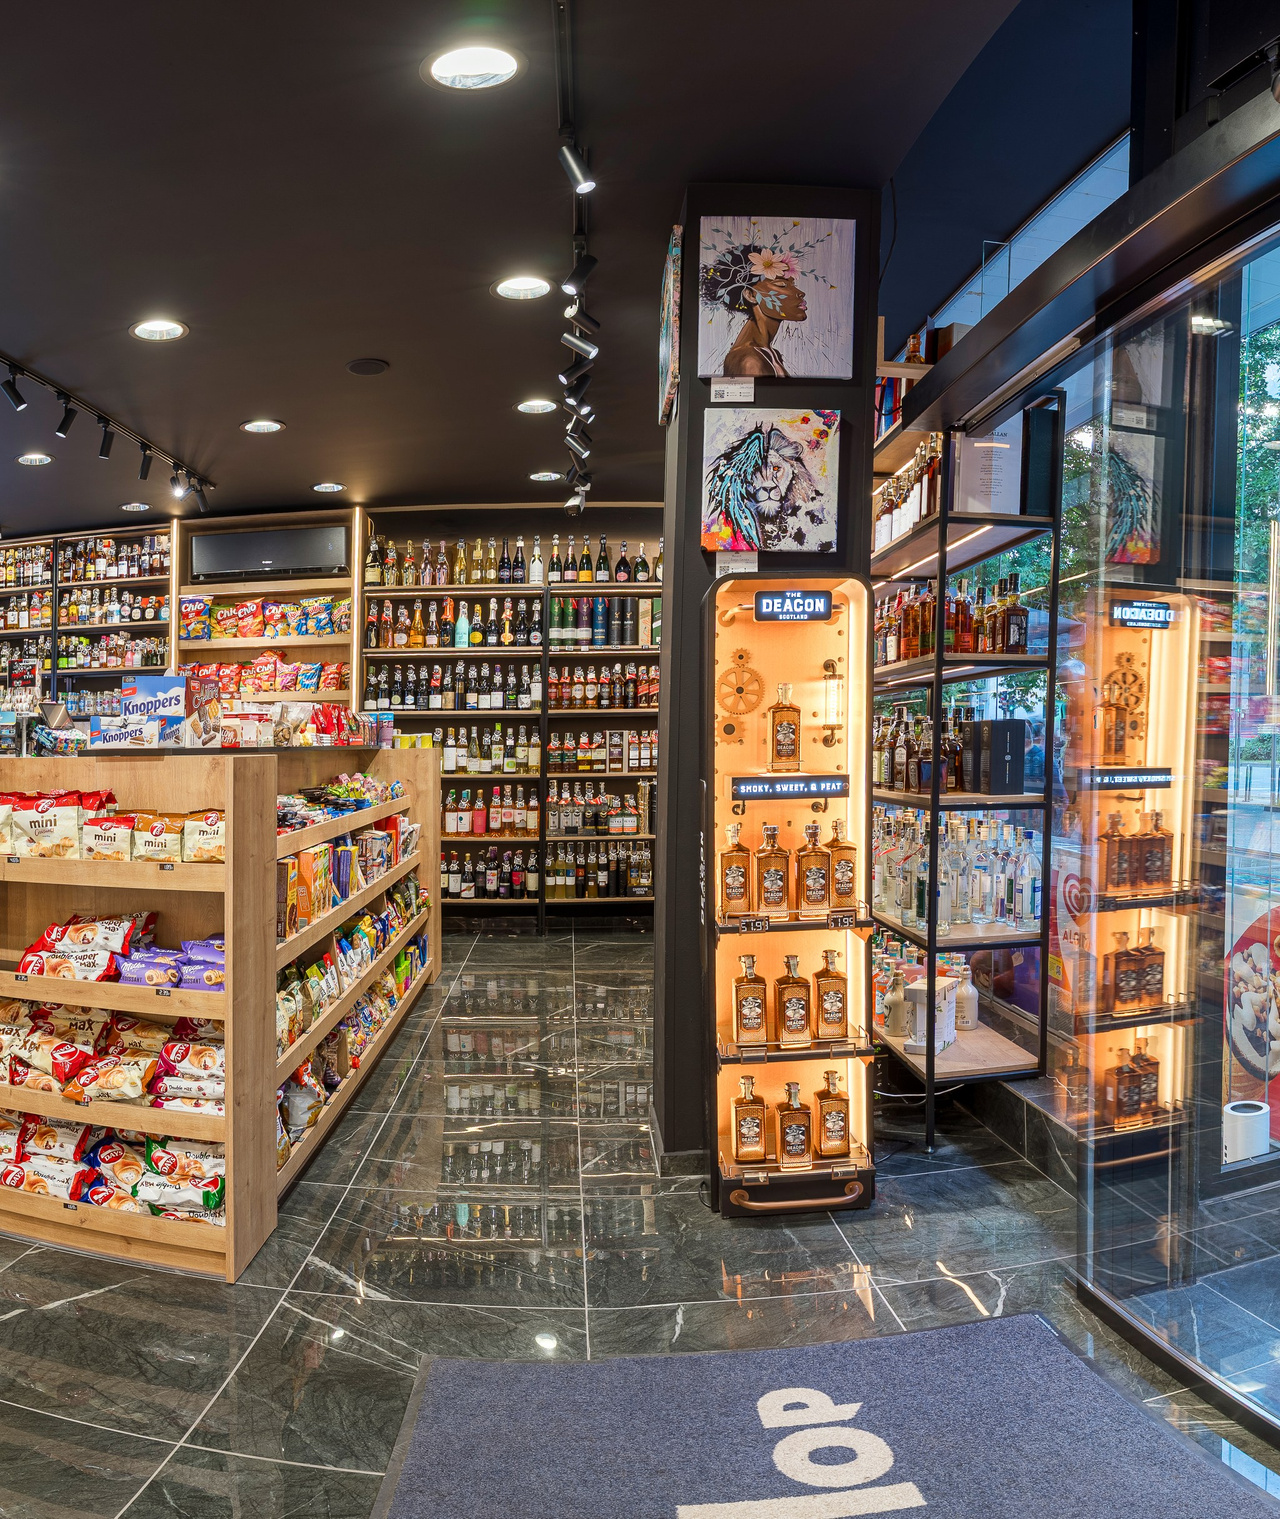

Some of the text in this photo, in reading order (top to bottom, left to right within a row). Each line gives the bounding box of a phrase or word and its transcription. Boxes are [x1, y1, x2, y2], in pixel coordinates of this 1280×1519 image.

[181, 602, 205, 612] Chio
[238, 603, 257, 618] Chio
[762, 599, 825, 613] DEACON
[123, 694, 181, 716] Knoppers
[102, 727, 144, 744] Knoppers
[740, 785, 772, 793] SMOKY,
[775, 784, 808, 793] SWEET,
[820, 783, 842, 791] PEAT
[29, 814, 57, 828] mini
[94, 832, 116, 842] mini
[198, 826, 220, 836] mini
[144, 838, 167, 848] mini
[121, 962, 146, 971] Milka
[104, 1149, 124, 1161] DAYS
[185, 1151, 210, 1162] Double
[162, 1156, 176, 1173] DAYS
[11, 1171, 25, 1187] DAYS
